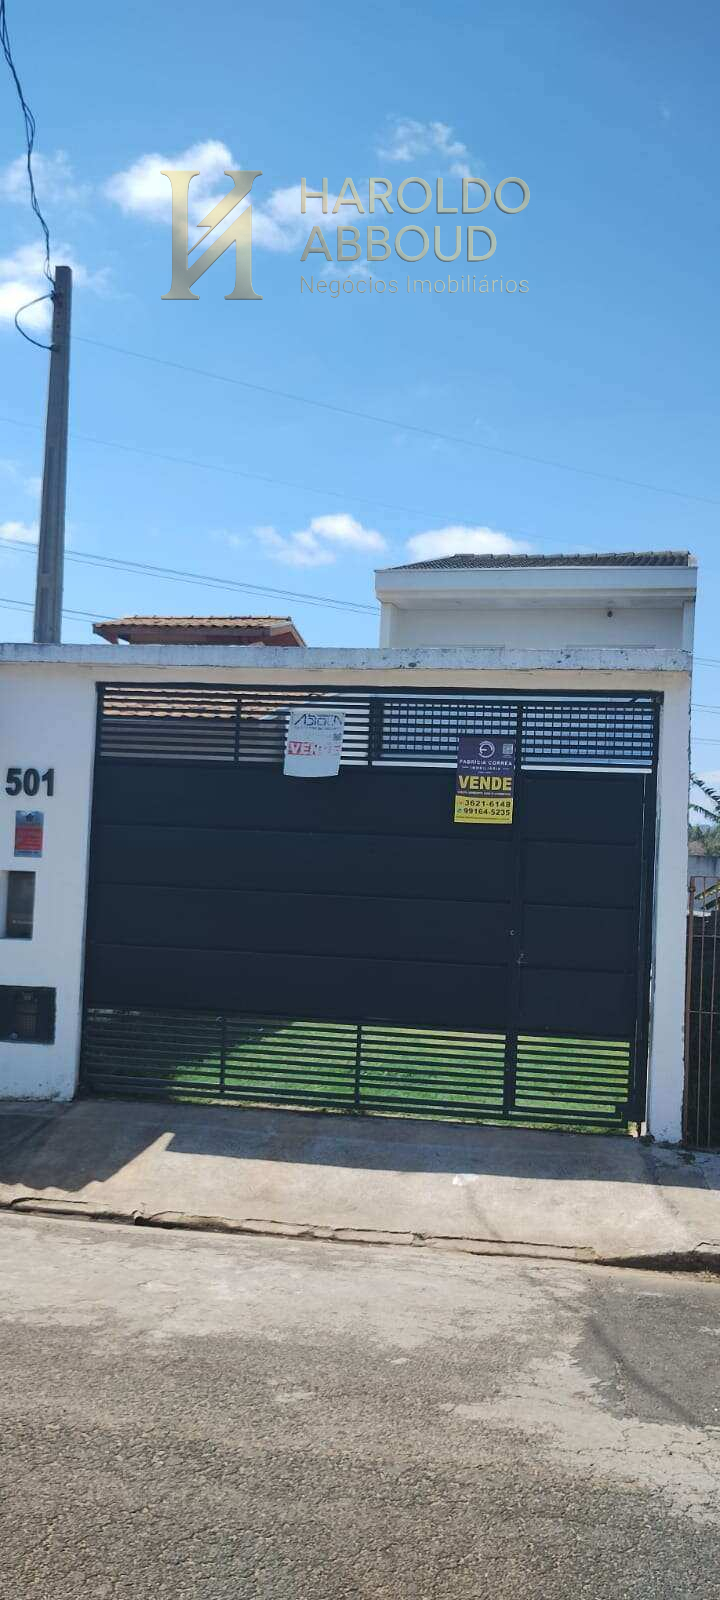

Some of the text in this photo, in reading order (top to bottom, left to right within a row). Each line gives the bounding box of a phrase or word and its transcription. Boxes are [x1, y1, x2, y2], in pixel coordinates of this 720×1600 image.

[5, 768, 55, 797] 501
[458, 775, 513, 791] VENDE
[464, 799, 511, 808] 3621-6148
